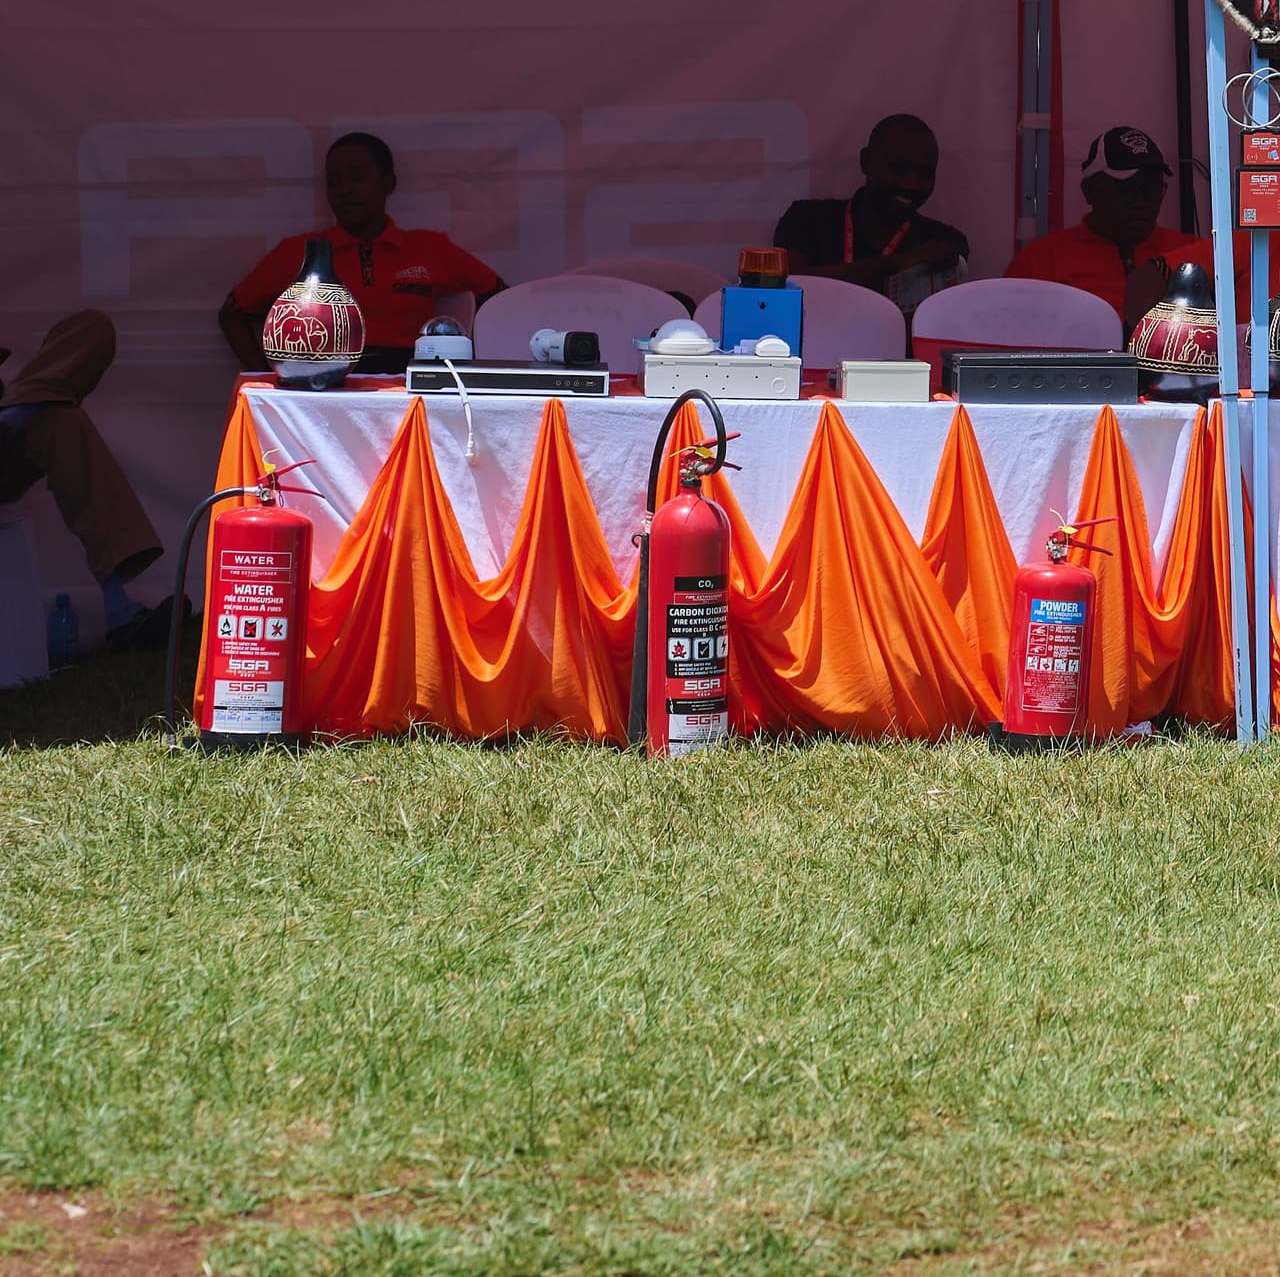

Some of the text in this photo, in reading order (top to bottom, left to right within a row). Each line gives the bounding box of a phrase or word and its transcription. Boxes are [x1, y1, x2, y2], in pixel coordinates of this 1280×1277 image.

[1251, 137, 1278, 146] SGA
[1251, 175, 1278, 183] SGA
[234, 555, 274, 565] WATER
[234, 584, 274, 596] WATER
[1040, 601, 1078, 612] POWDER
[670, 608, 704, 616] CARBON
[228, 659, 269, 671] SGA
[228, 682, 268, 692] SGA
[684, 678, 720, 690] SGA
[686, 714, 720, 726] SGA
